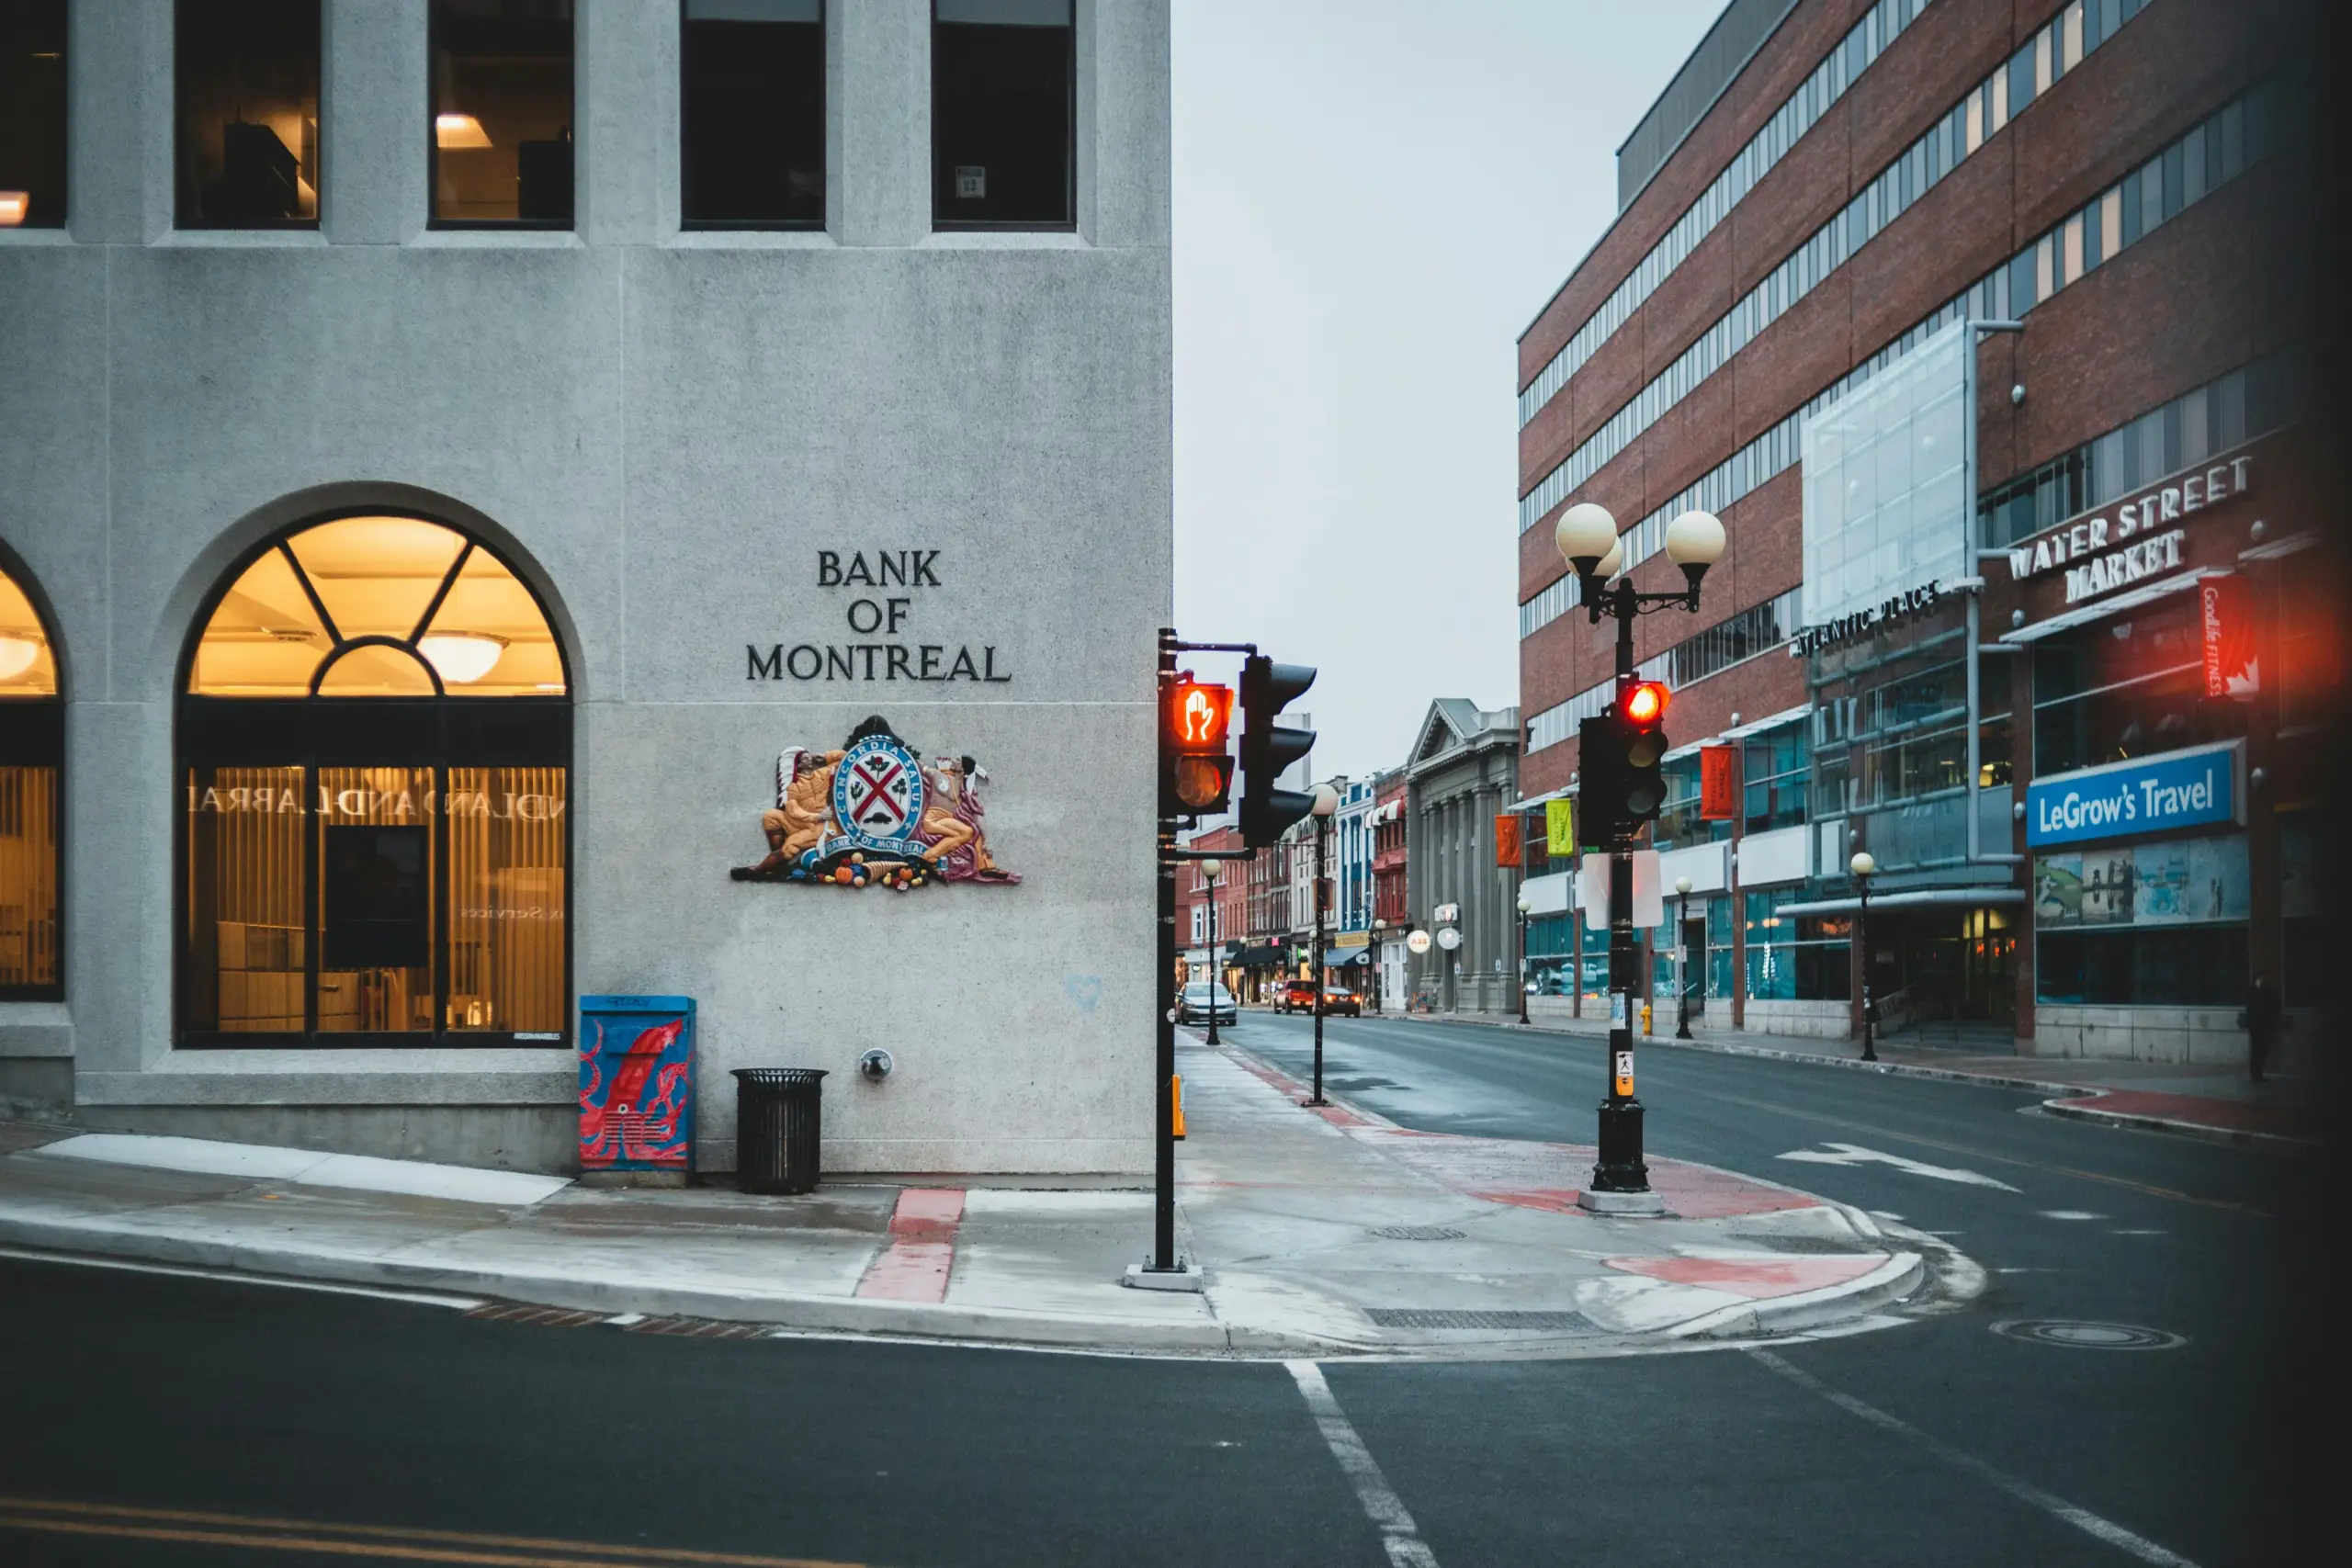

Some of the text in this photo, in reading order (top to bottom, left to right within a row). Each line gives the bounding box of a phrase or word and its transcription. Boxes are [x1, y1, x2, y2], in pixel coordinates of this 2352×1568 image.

[2009, 456, 2252, 581] WATER STREET
[817, 549, 942, 587] BANK
[2064, 529, 2185, 604] MARKET
[847, 598, 910, 634] OF
[1796, 580, 1940, 658] ATLANTIC PLACE
[746, 643, 1012, 682] MONTREAL
[836, 741, 921, 814] CONCORDIA SALUS
[2040, 769, 2212, 833] LeGrow's Travel
[828, 836, 923, 854] BANK OF MONTREAL
